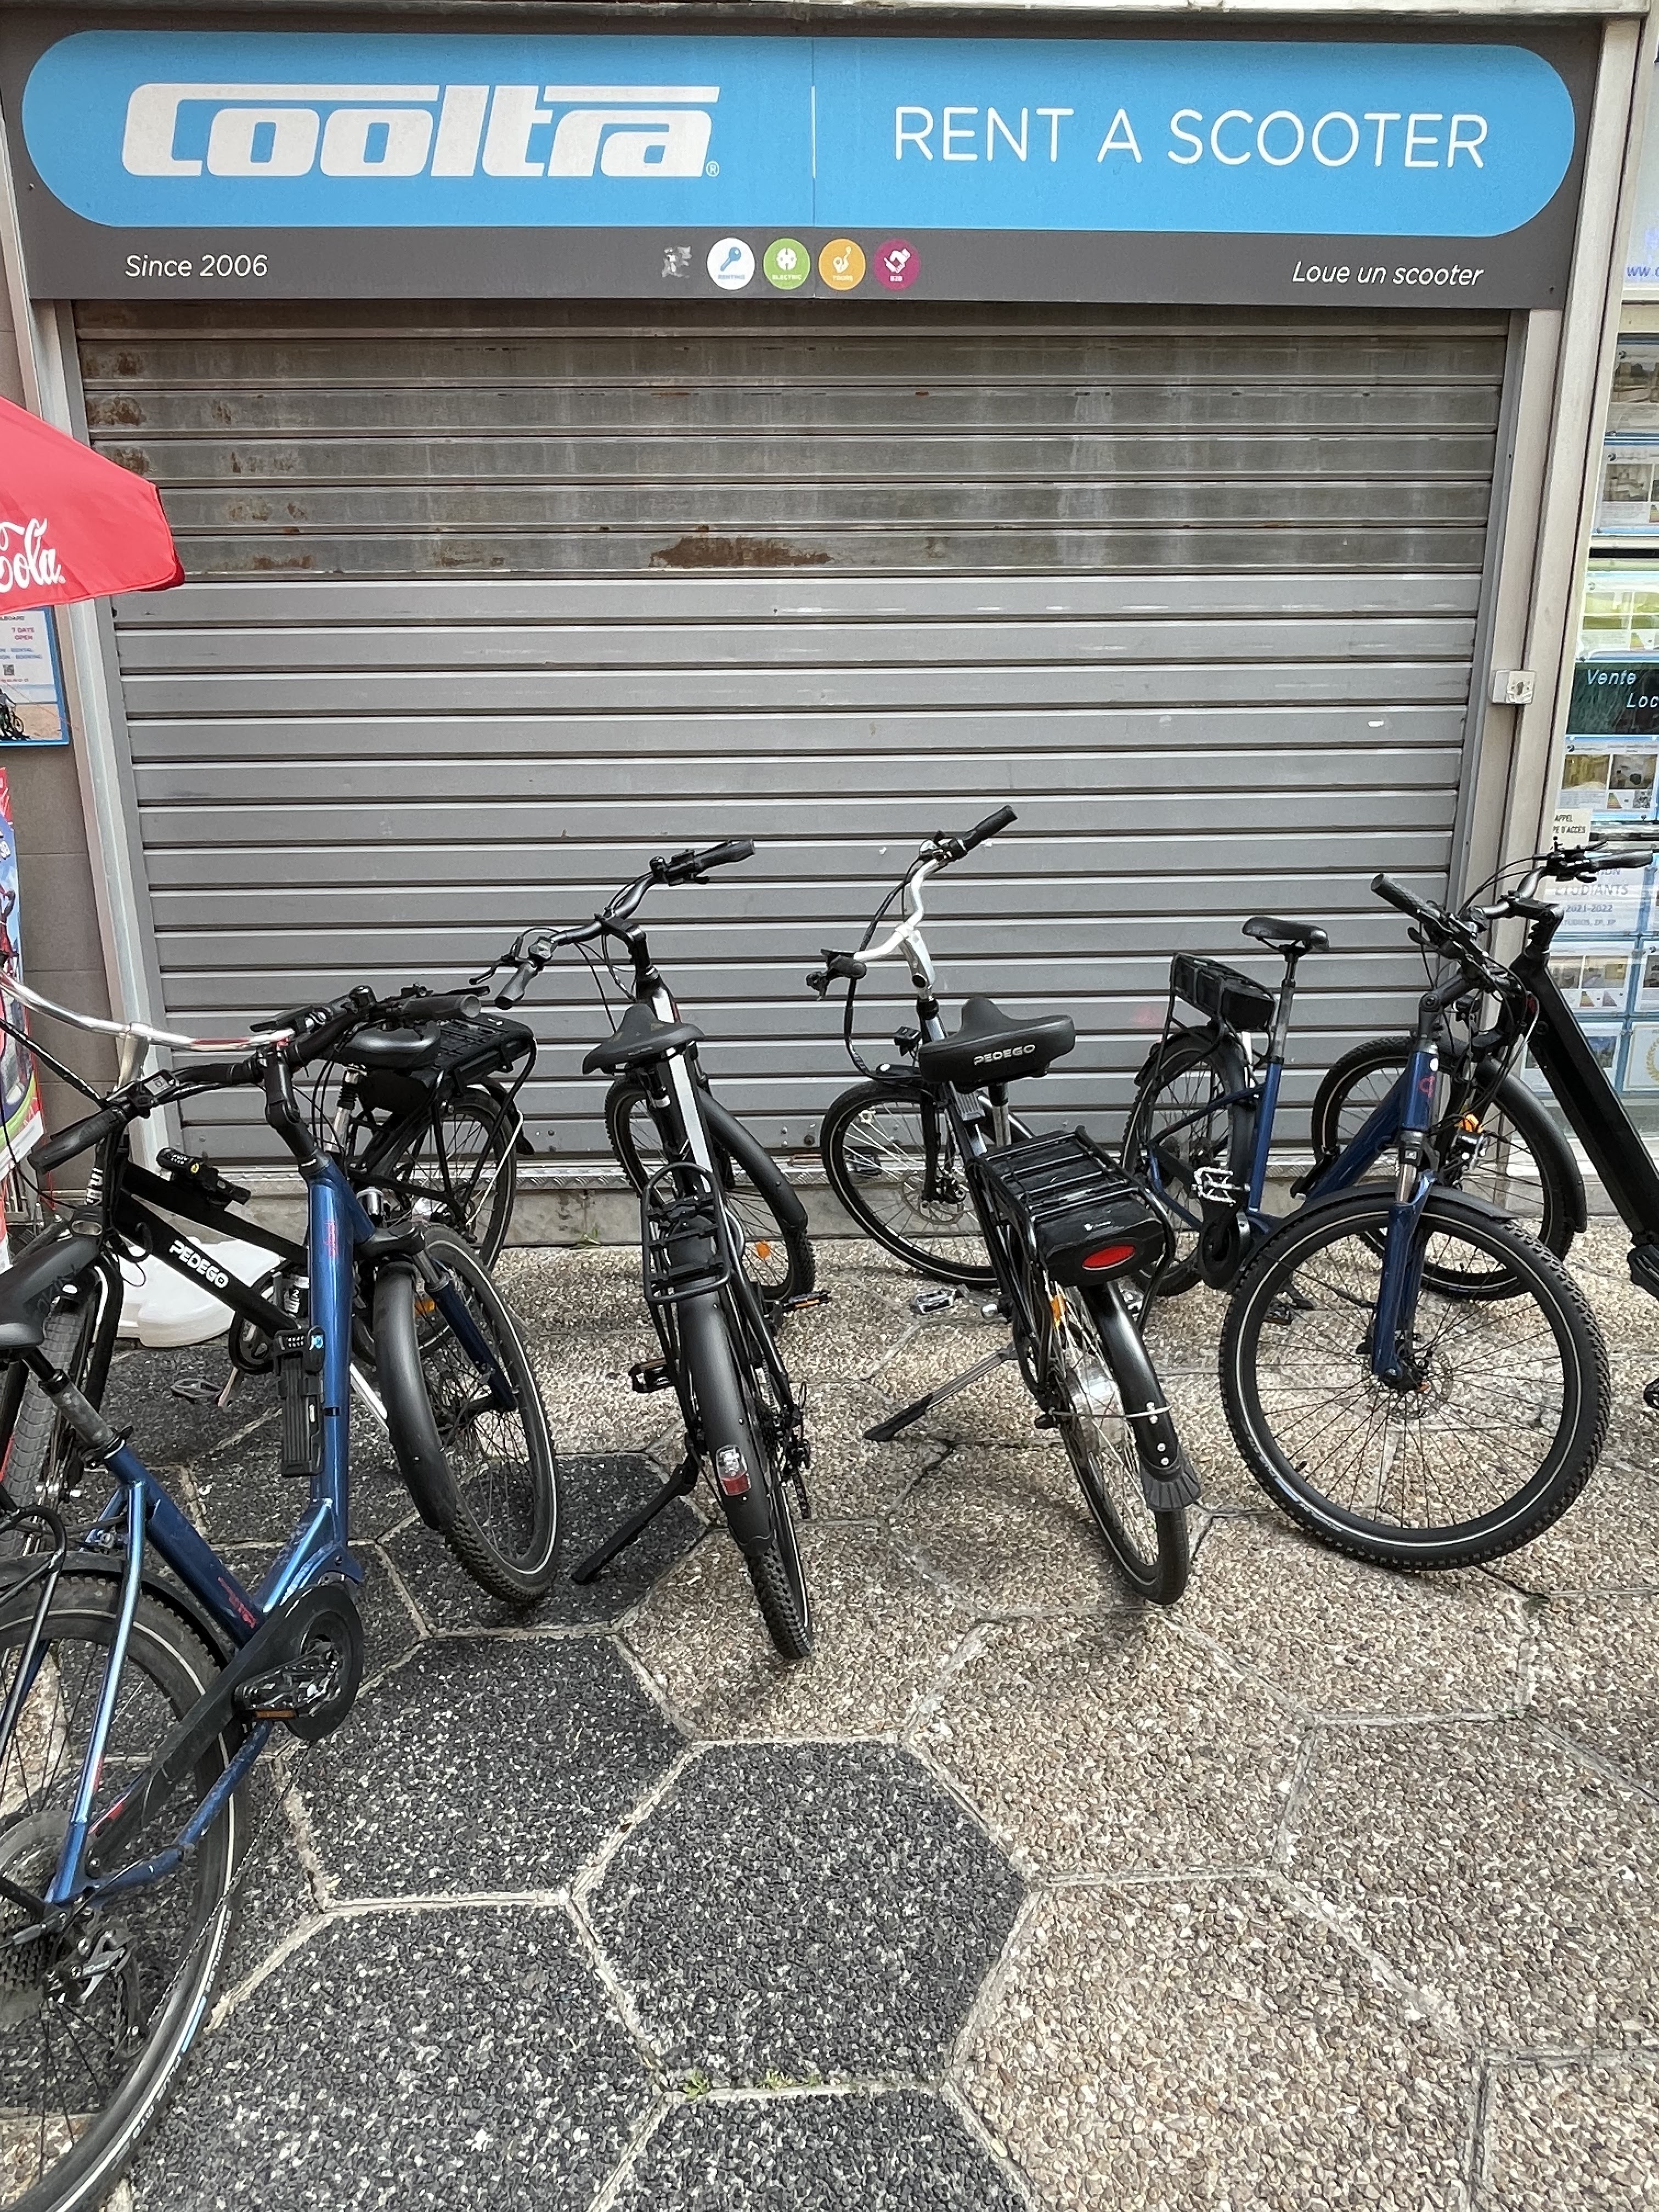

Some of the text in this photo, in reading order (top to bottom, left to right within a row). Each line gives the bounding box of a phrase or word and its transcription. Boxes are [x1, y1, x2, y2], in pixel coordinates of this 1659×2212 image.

[896, 106, 1488, 168] RENT A SCOOTER
[126, 255, 268, 278] Since 2006
[1293, 261, 1485, 286] Loue un scooter
[1587, 668, 1637, 685] Vente
[1554, 814, 1573, 822] APPEL
[1566, 904, 1613, 913] 2021-2022
[973, 1044, 1036, 1065] PEDEGO
[169, 1240, 229, 1288] PEDEGO
